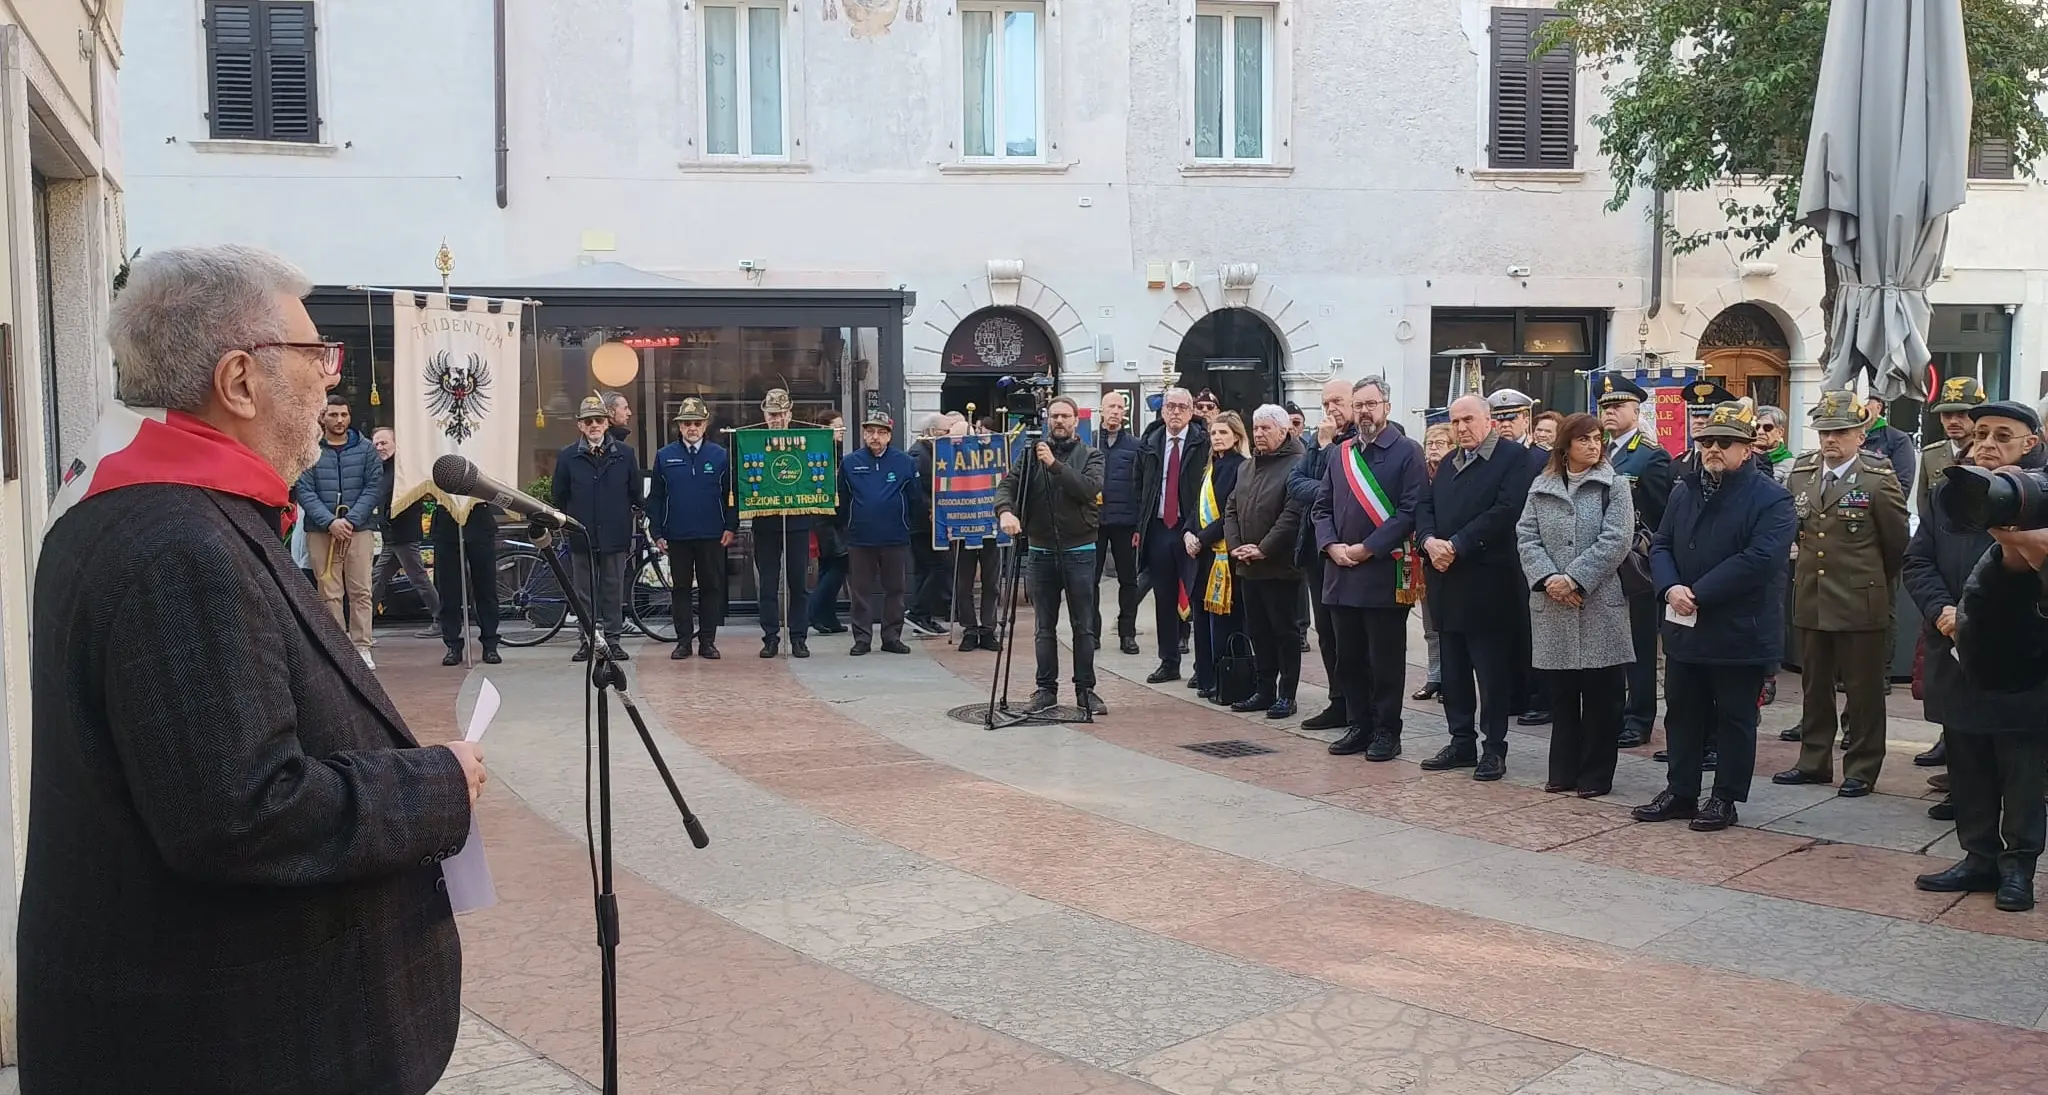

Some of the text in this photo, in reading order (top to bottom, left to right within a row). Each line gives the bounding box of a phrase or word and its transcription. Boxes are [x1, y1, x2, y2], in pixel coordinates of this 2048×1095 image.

[411, 317, 504, 349] TRIDENTUM
[955, 448, 1006, 470] A.N.P.I.
[745, 494, 829, 506] SEZIONE DI TRENTO
[978, 496, 994, 504] NAZION
[960, 525, 985, 533] BOLZANO
